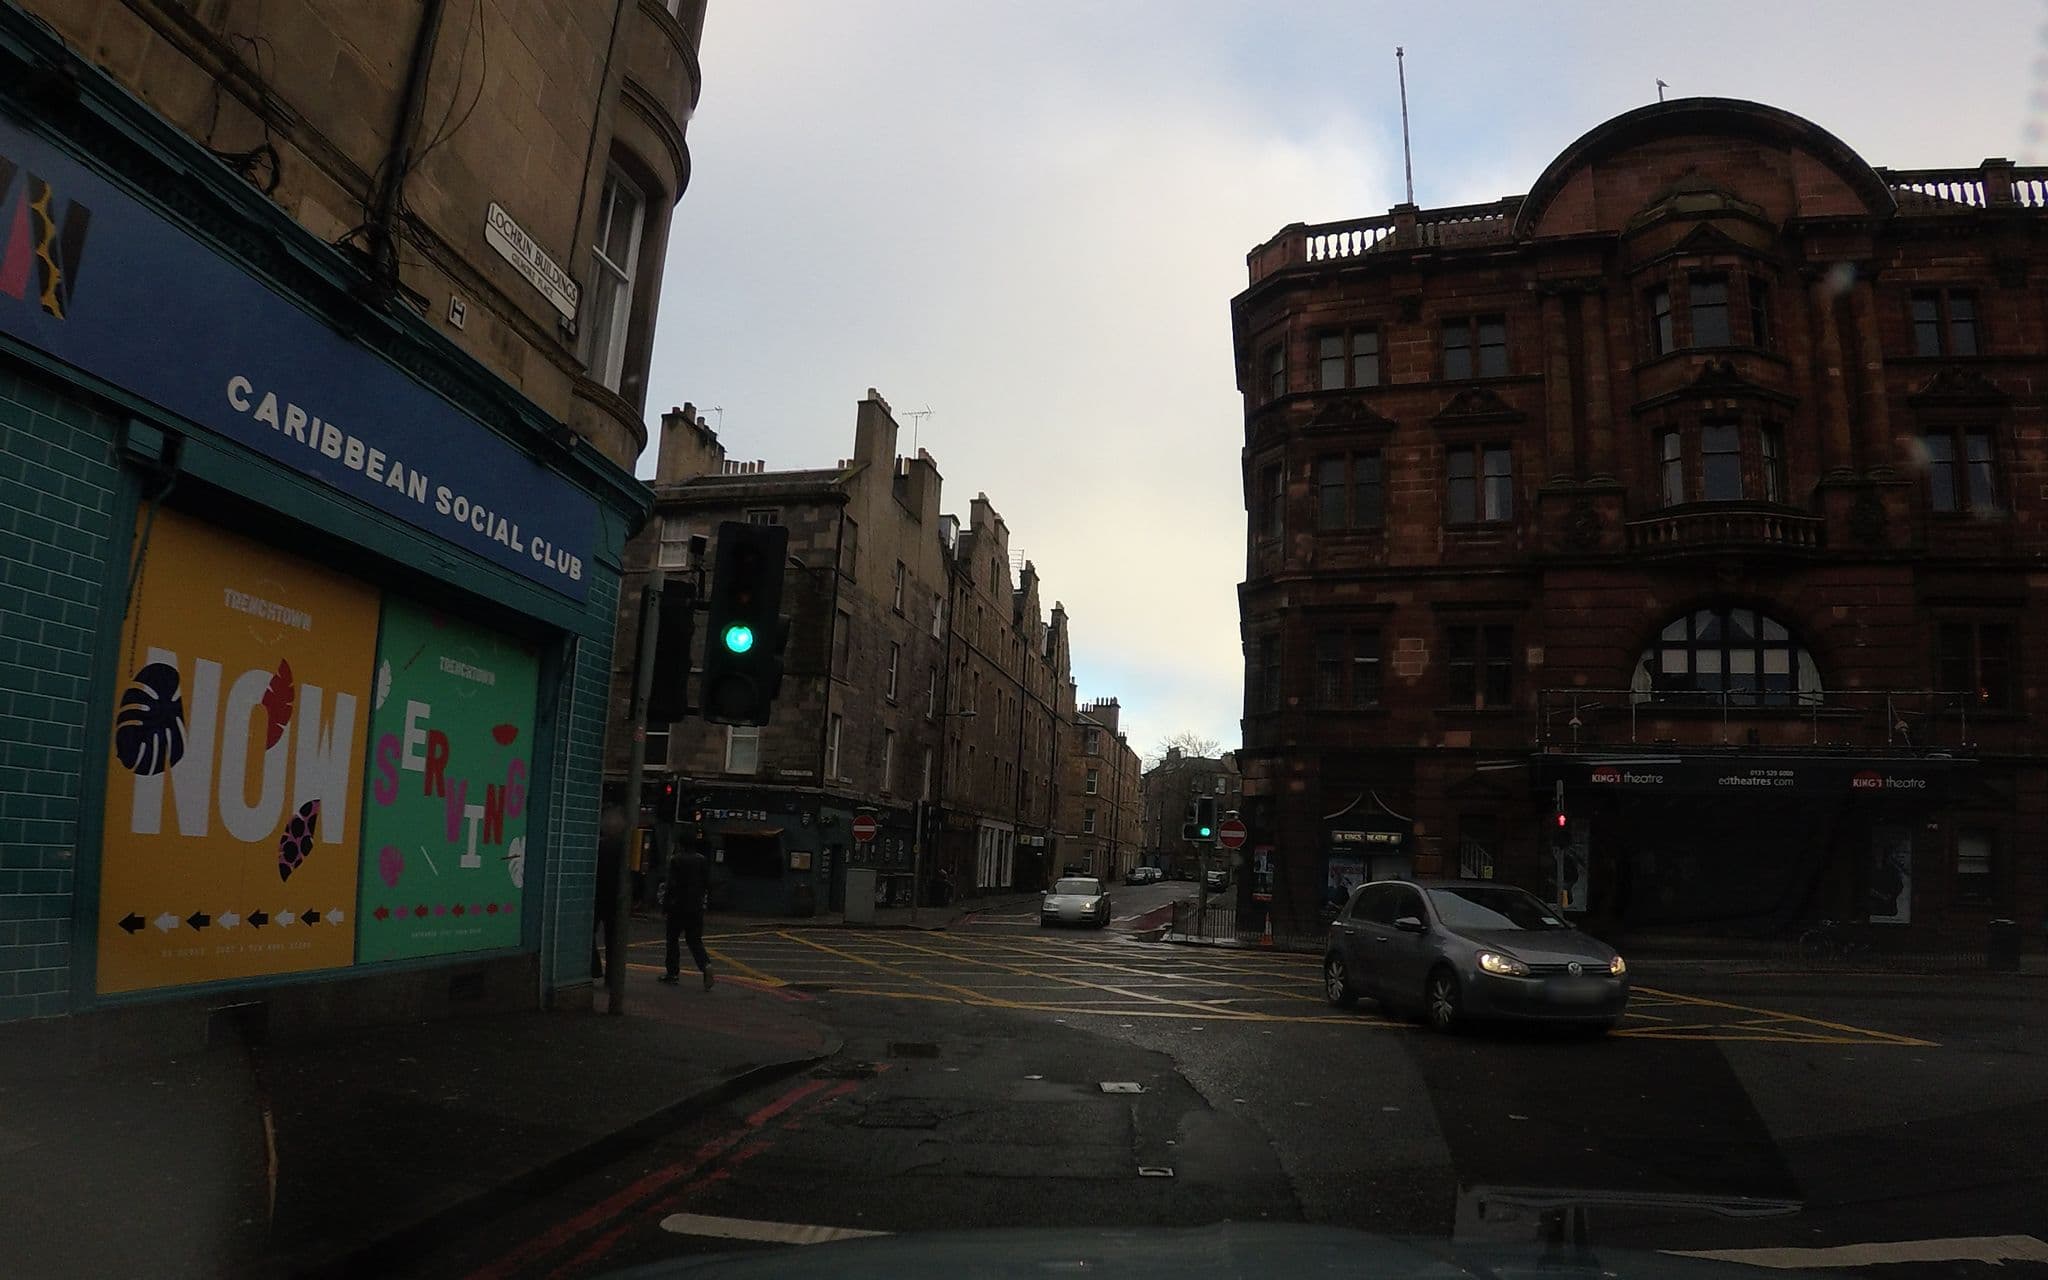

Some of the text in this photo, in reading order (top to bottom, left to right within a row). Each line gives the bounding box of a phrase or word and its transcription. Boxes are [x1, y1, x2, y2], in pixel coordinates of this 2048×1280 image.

[490, 204, 576, 302] LOCHRIN BUILDINGS
[226, 375, 583, 581] CARIBBEAN SOCIAL CLUB
[131, 646, 358, 845] NOW
[374, 699, 527, 869] SERVING
[1623, 771, 1664, 784] theatre
[1885, 775, 1927, 789] theatre
